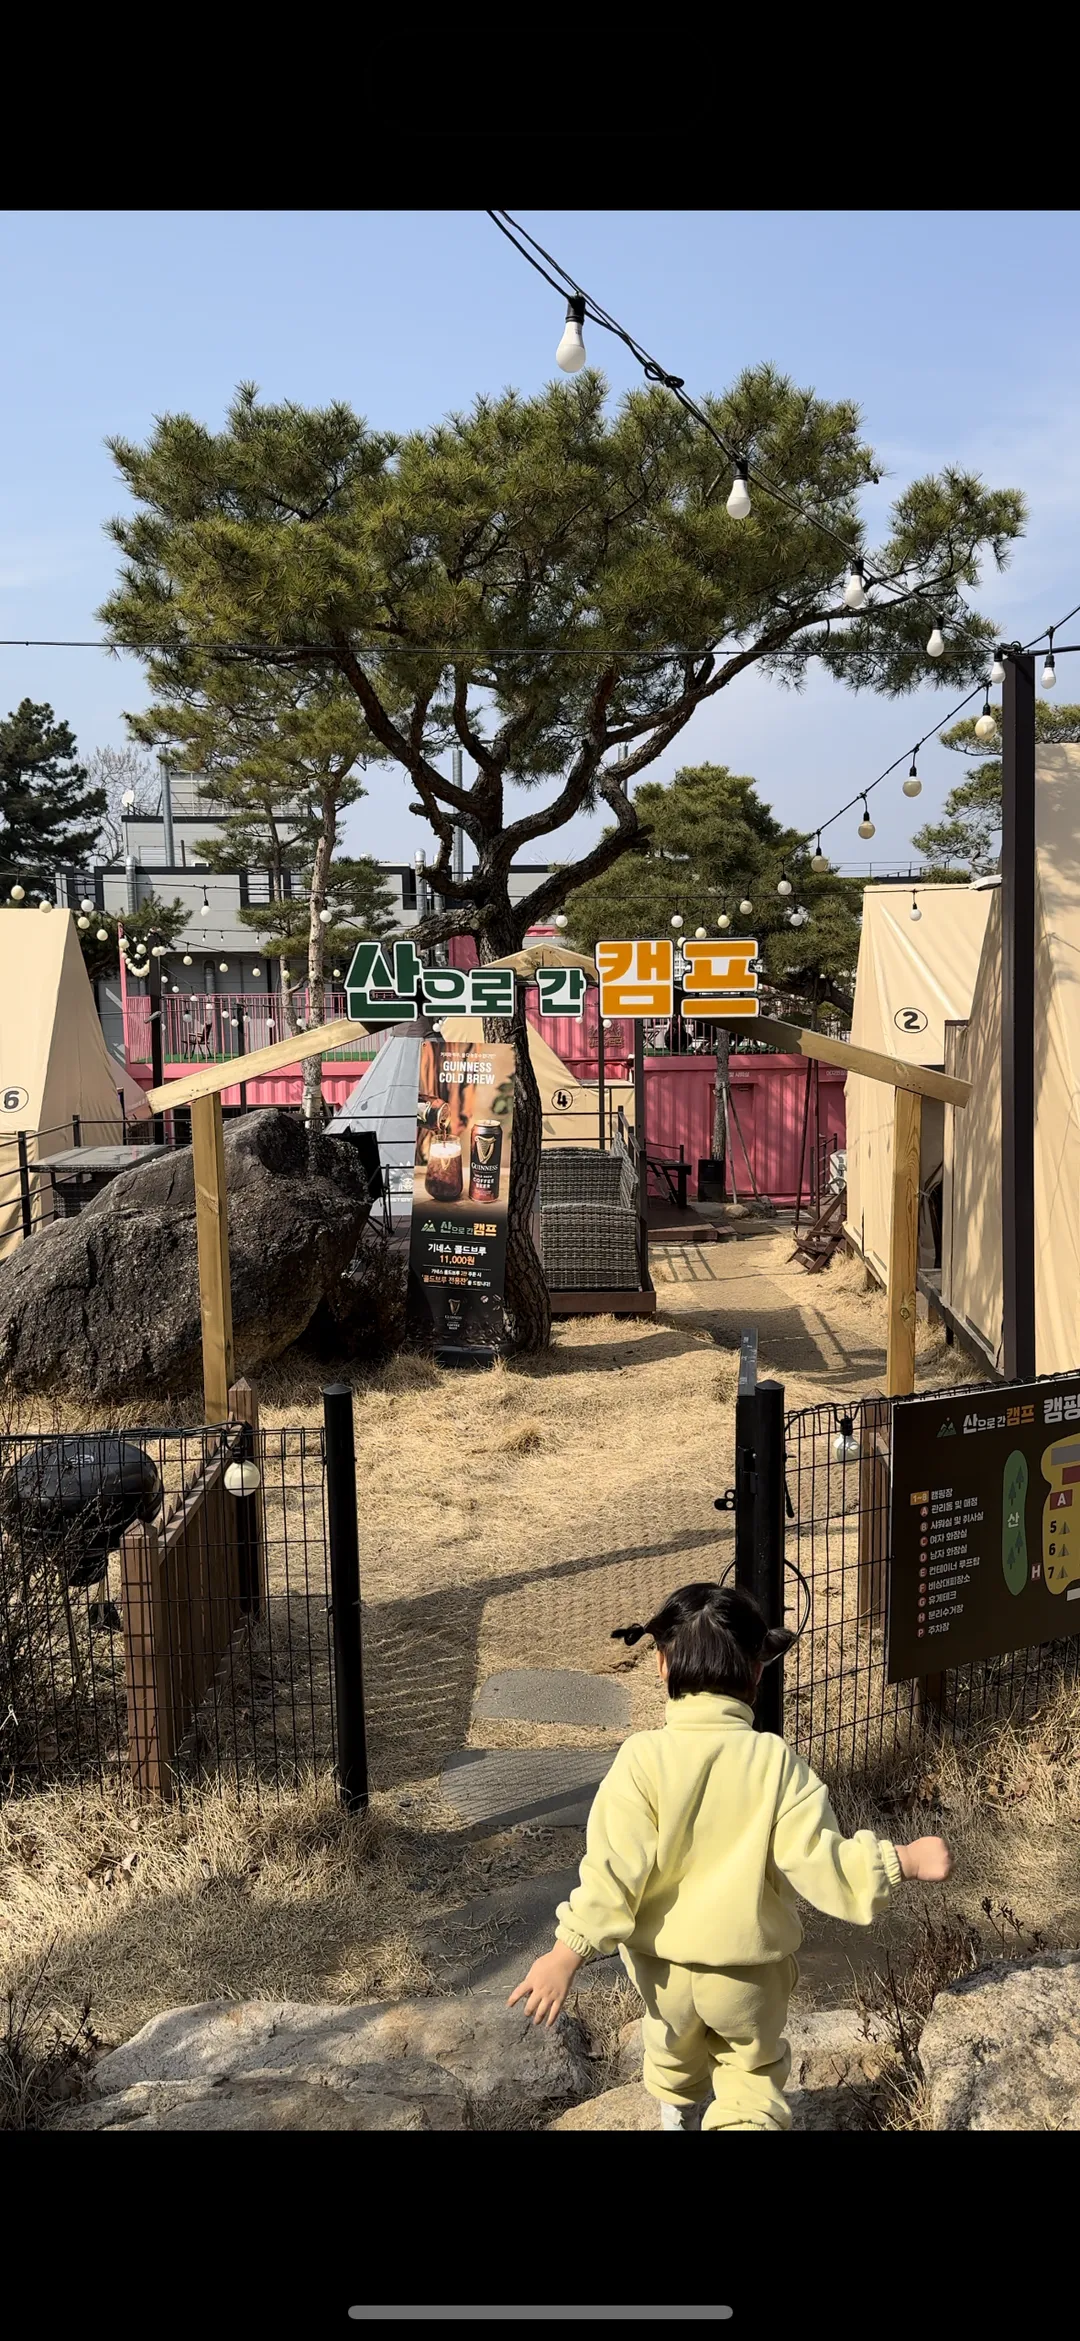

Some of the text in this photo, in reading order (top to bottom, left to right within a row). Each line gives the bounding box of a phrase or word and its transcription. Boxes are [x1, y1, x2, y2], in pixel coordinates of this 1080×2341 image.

[346, 939, 759, 1021] 산으로 간 캠프
[903, 1011, 920, 1029] 2
[443, 1061, 493, 1073] GUINNESS
[439, 1073, 495, 1085] COLD BREW
[4, 1090, 19, 1109] 6
[557, 1092, 568, 1107] 4
[471, 1162, 498, 1171] GUINNESS
[440, 1221, 465, 1235] 산으로
[473, 1223, 497, 1236] 캠프
[428, 1243, 487, 1256] 기네스 콜드브루
[440, 1255, 475, 1265] 11,000원
[963, 1413, 996, 1435] 산으로
[1006, 1404, 1035, 1427] 캠프
[931, 1488, 953, 1500] 캠핑장
[1057, 1493, 1066, 1506] A
[921, 1497, 978, 1516] A 관리동 및 매점
[921, 1511, 984, 1531] B 샤워실 및 취사실
[1007, 1512, 1020, 1528] 산
[1050, 1520, 1057, 1533] 5
[921, 1529, 967, 1546] C 여자 화장실
[930, 1549, 944, 1560] 남자
[946, 1544, 968, 1556] 화장실
[1048, 1543, 1056, 1556] 6
[920, 1557, 980, 1576] E 컨테이너 루프탑
[1031, 1565, 1040, 1579] H
[1048, 1566, 1055, 1579] 7
[920, 1574, 970, 1592] F 비상대피장소
[929, 1604, 964, 1620] 분리수거장
[918, 1622, 950, 1637] P 주차장
